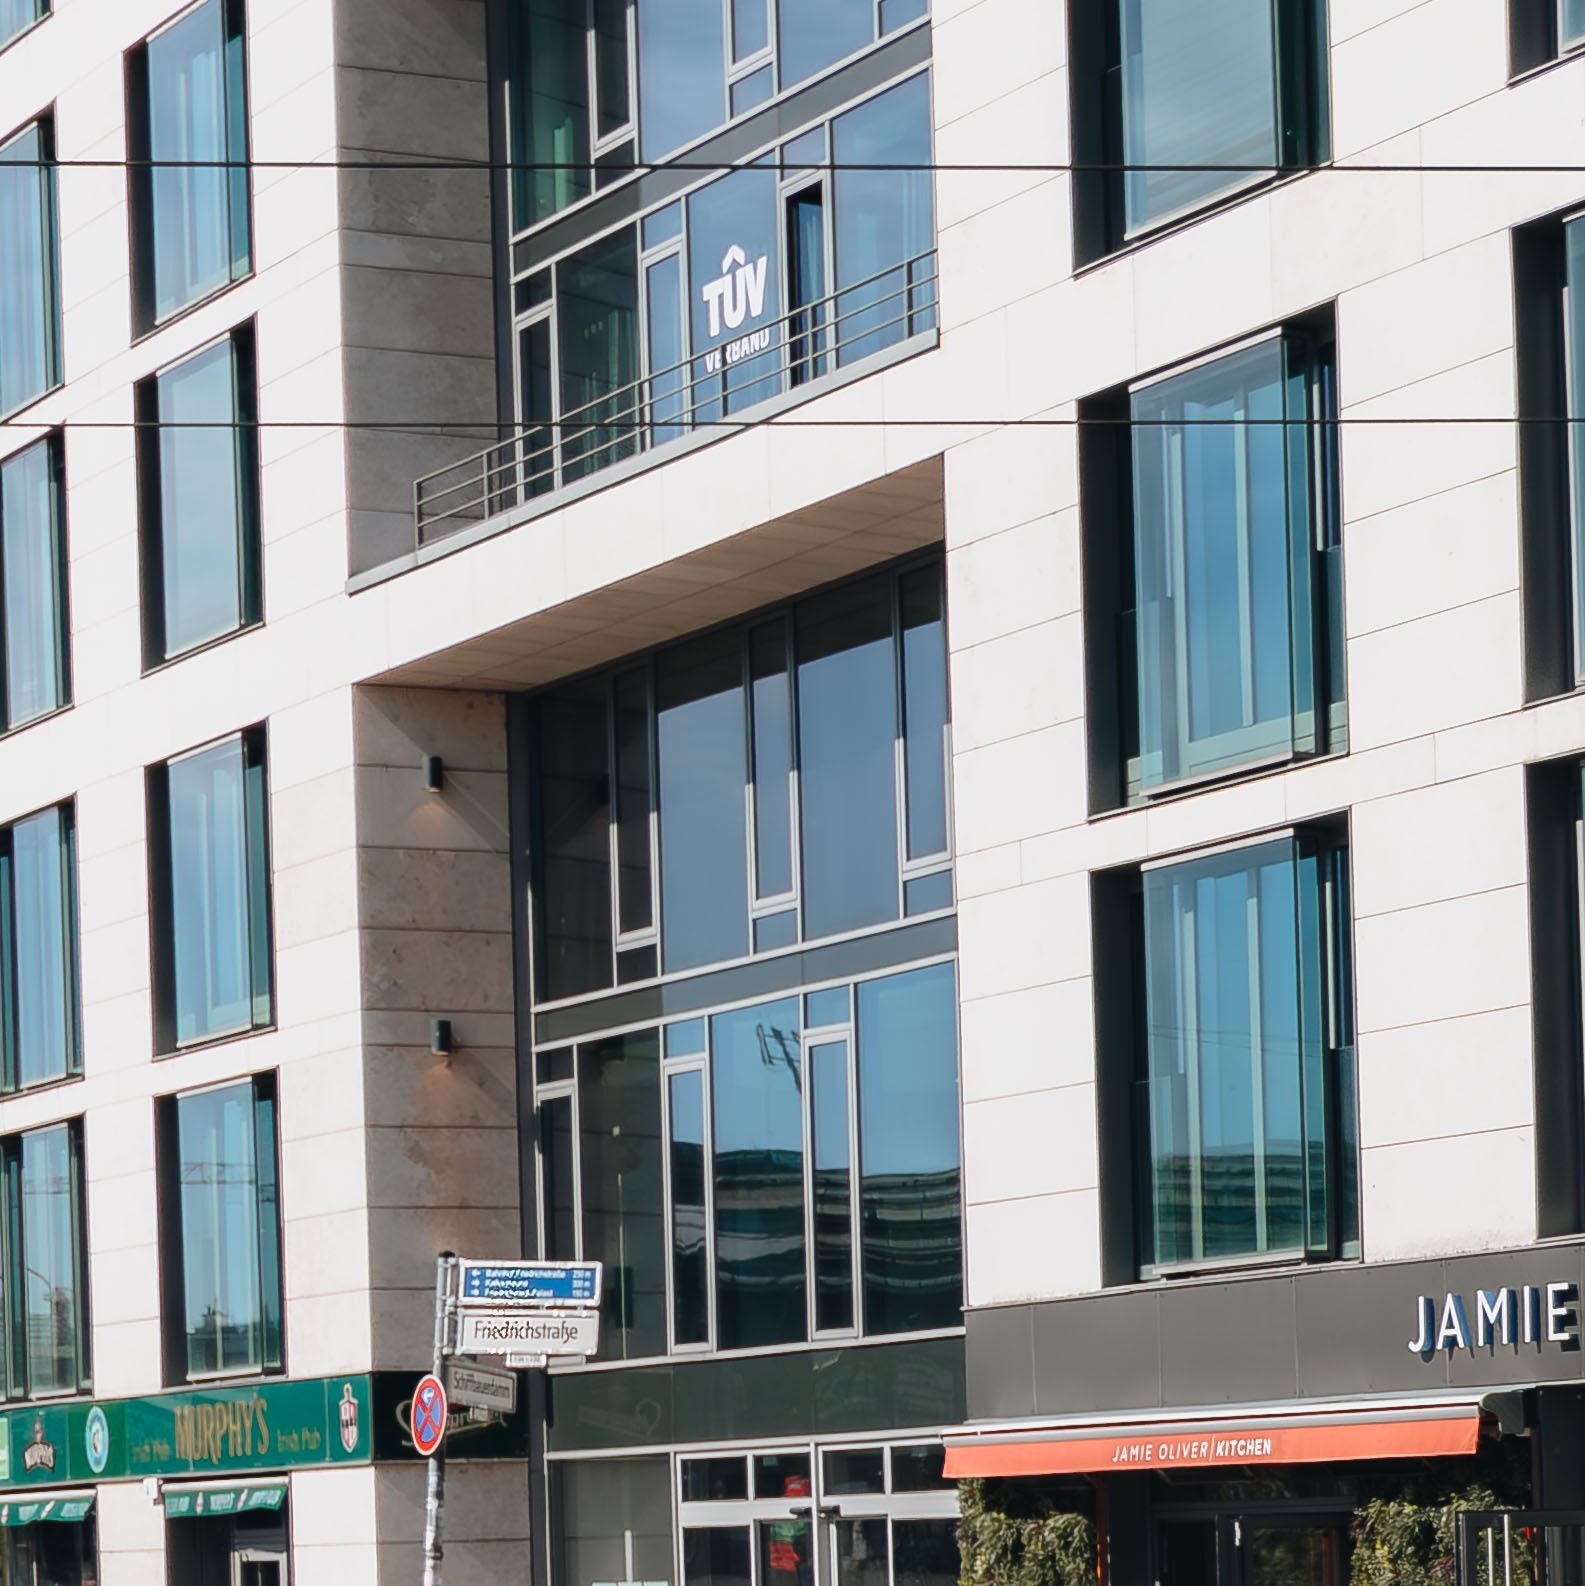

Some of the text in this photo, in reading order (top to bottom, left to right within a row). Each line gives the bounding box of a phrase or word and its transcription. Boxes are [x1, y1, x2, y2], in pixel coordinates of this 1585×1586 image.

[474, 1320, 578, 1344] Friedrichstraße
[1408, 1282, 1572, 1352] JAMIE
[174, 1394, 270, 1464] MURPHY'S
[1112, 1438, 1272, 1462] JAMIE OLIVER KITCHEN
